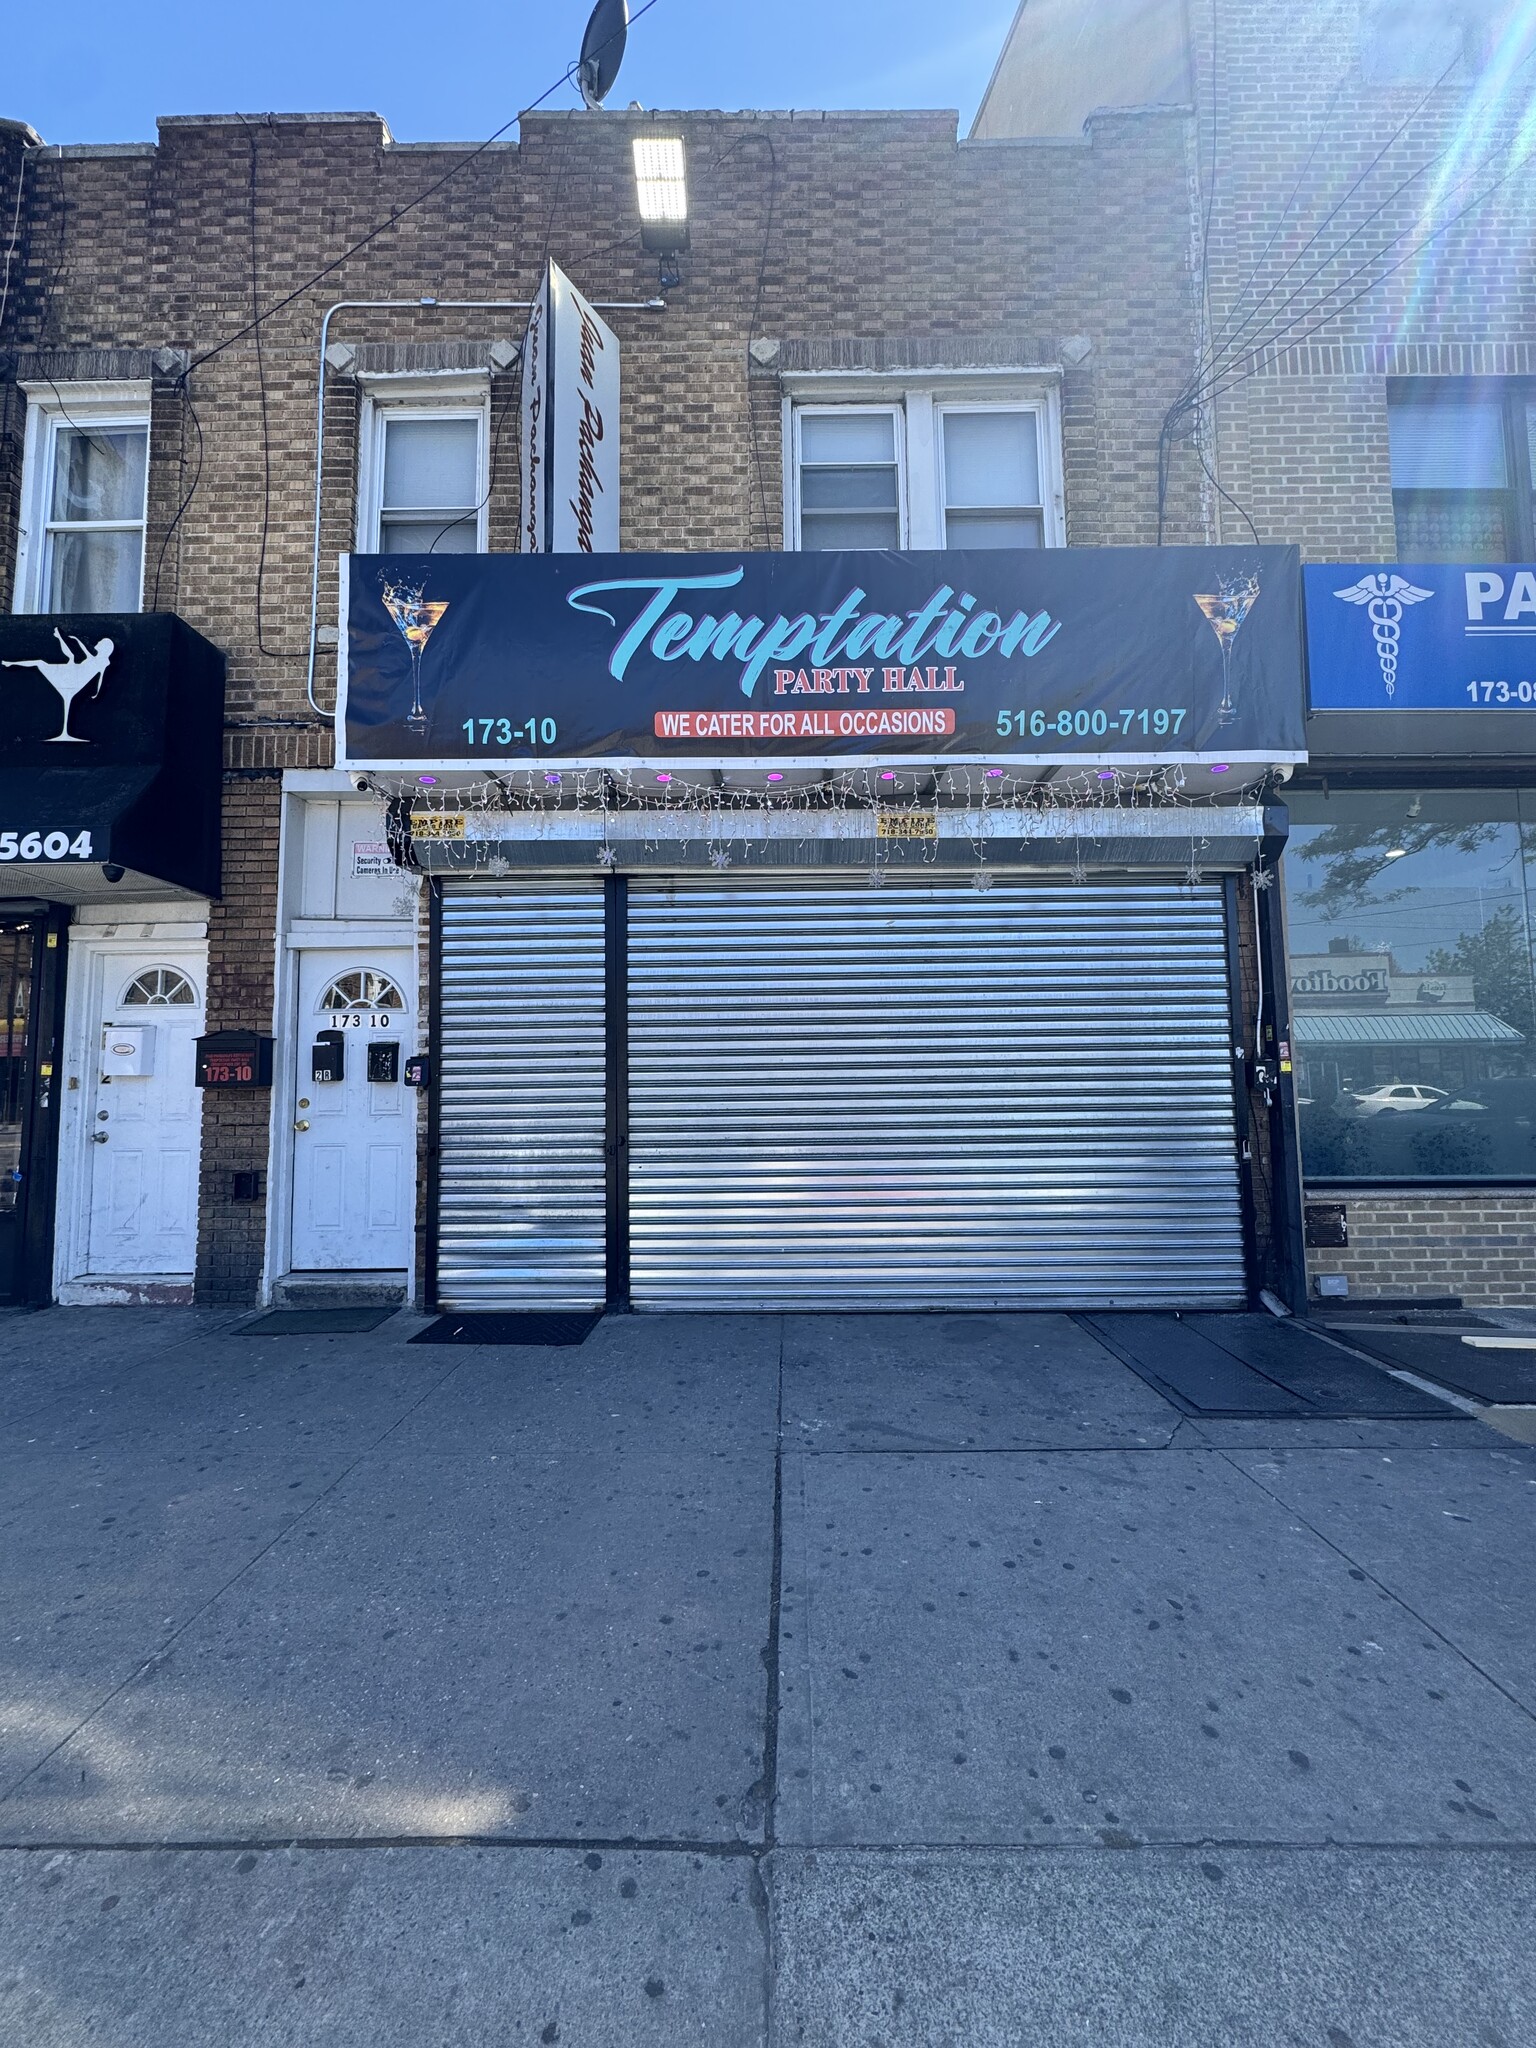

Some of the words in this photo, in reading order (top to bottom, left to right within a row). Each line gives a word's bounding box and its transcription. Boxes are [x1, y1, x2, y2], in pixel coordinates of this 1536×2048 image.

[570, 291, 605, 391] Juan
[1464, 570, 1536, 621] PA
[566, 564, 1062, 699] Temptation
[773, 668, 875, 695] PARTY
[882, 666, 965, 692] HALL
[1466, 680, 1536, 703] 173-0
[462, 717, 557, 745] 173-10
[661, 713, 691, 737] WE
[695, 713, 755, 736] CATER
[760, 712, 797, 736] FOR
[800, 712, 836, 735] ALL
[838, 710, 946, 735] OCCASIONS
[996, 708, 1187, 737] 516-800-7197
[0, 830, 93, 861] 5604
[356, 843, 390, 853] WARNI
[356, 856, 382, 866] Security
[356, 866, 381, 875] Cameras
[331, 1014, 361, 1028] 173
[370, 1014, 389, 1028] 10
[205, 1066, 252, 1082] 173-10
